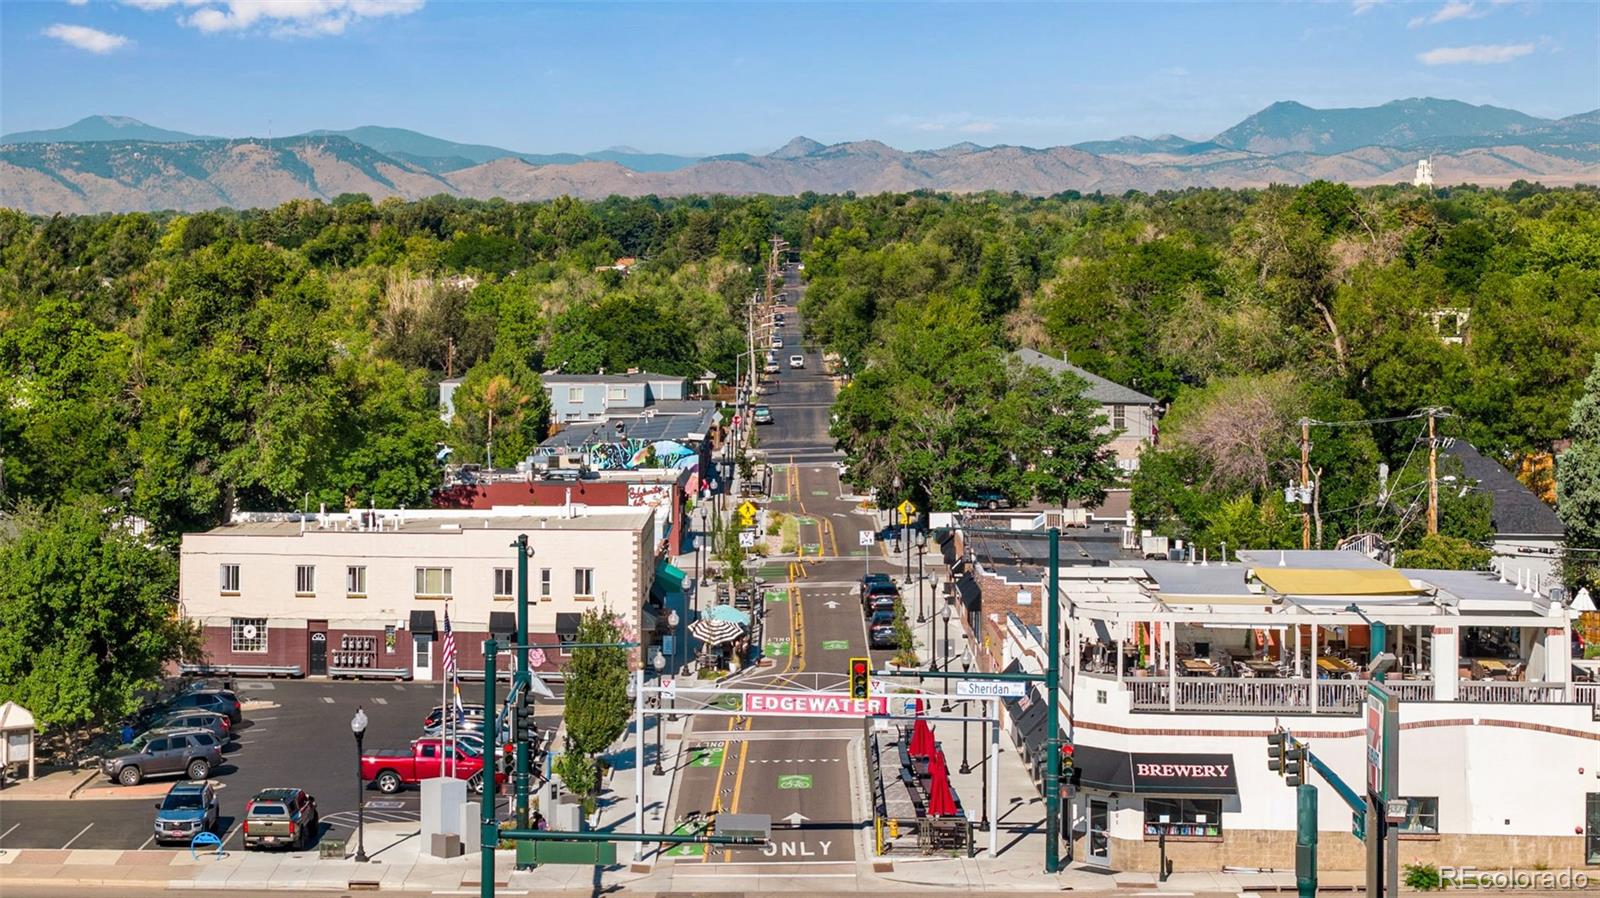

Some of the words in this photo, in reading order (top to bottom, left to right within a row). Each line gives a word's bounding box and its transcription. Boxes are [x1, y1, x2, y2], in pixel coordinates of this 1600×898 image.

[968, 683, 1009, 695] Sheridan
[751, 695, 882, 713] EDGEWATER
[1136, 763, 1230, 777] BREWERY
[763, 840, 833, 857] ONLY
